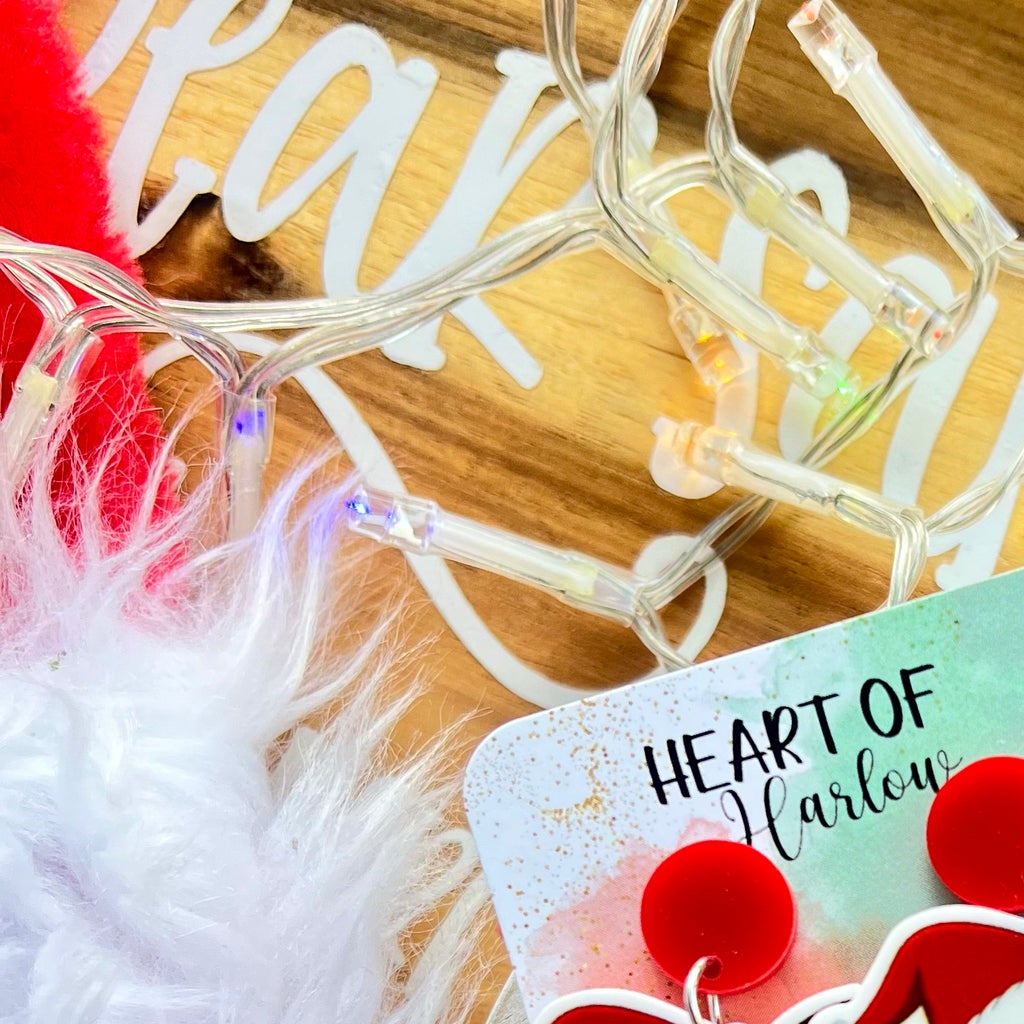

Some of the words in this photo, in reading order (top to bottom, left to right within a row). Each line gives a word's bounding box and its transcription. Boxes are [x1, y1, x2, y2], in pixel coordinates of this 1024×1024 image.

[642, 693, 839, 805] HEART
[860, 663, 934, 738] OF
[720, 747, 963, 862] Harlow
